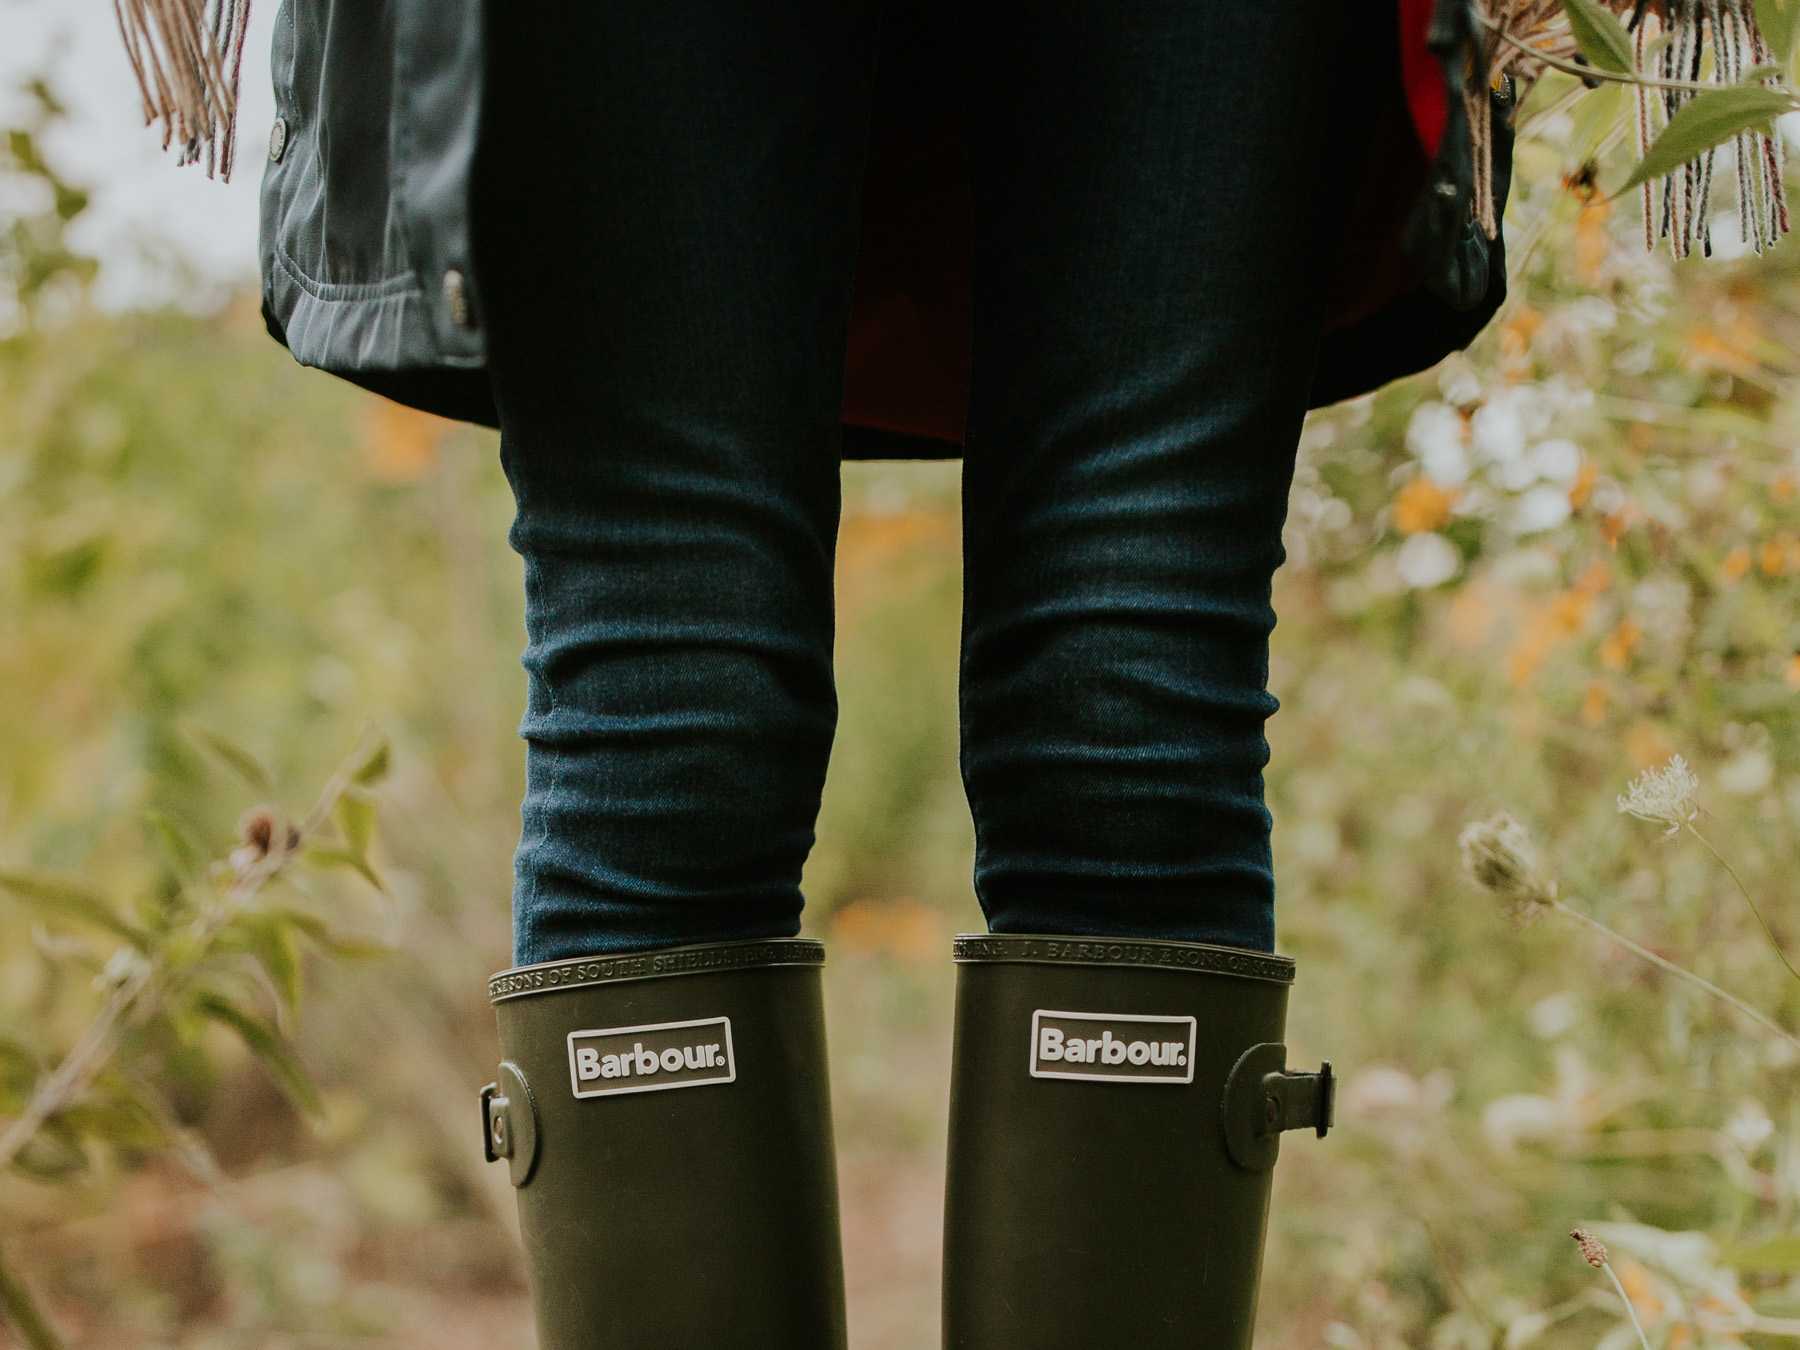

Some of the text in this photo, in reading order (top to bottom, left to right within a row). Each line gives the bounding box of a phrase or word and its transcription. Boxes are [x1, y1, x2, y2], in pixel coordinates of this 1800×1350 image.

[1021, 940, 1039, 957] J.
[1047, 942, 1156, 964] BARBOUR
[1176, 949, 1223, 969] SONS
[1228, 955, 1250, 971] OF
[508, 971, 544, 991] SONS
[549, 966, 573, 985] OF
[577, 957, 647, 980] SOUTH
